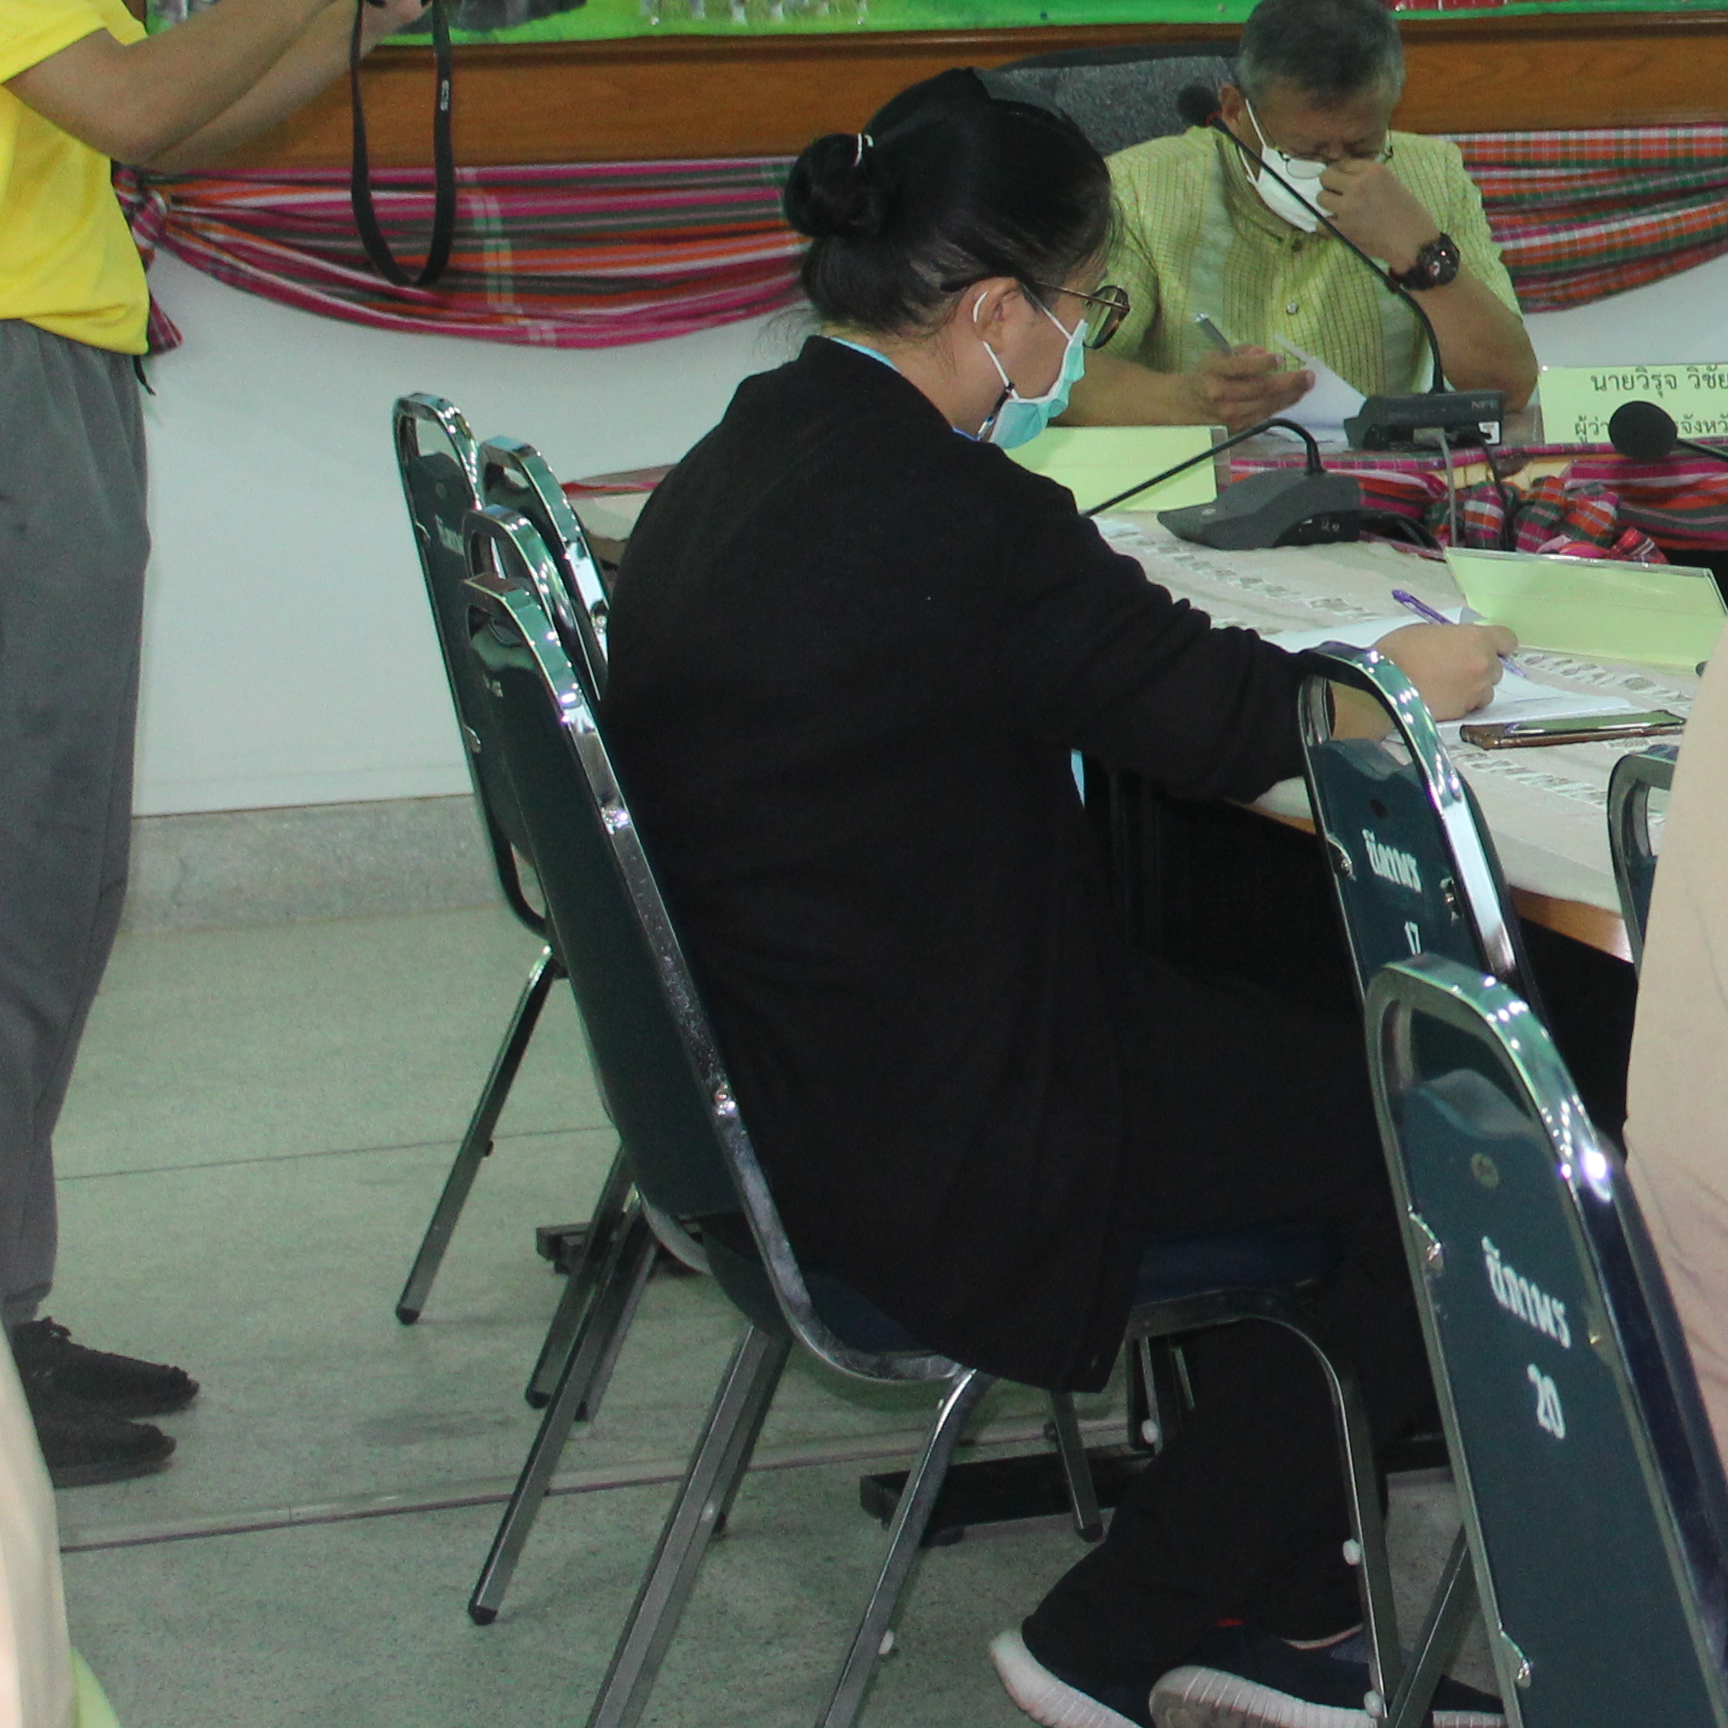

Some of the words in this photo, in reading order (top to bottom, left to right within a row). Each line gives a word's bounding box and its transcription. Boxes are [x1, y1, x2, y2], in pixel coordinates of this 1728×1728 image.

[1590, 364, 1678, 399] นายวิรุจ
[1403, 920, 1422, 956] 17
[1526, 1362, 1567, 1440] 20
